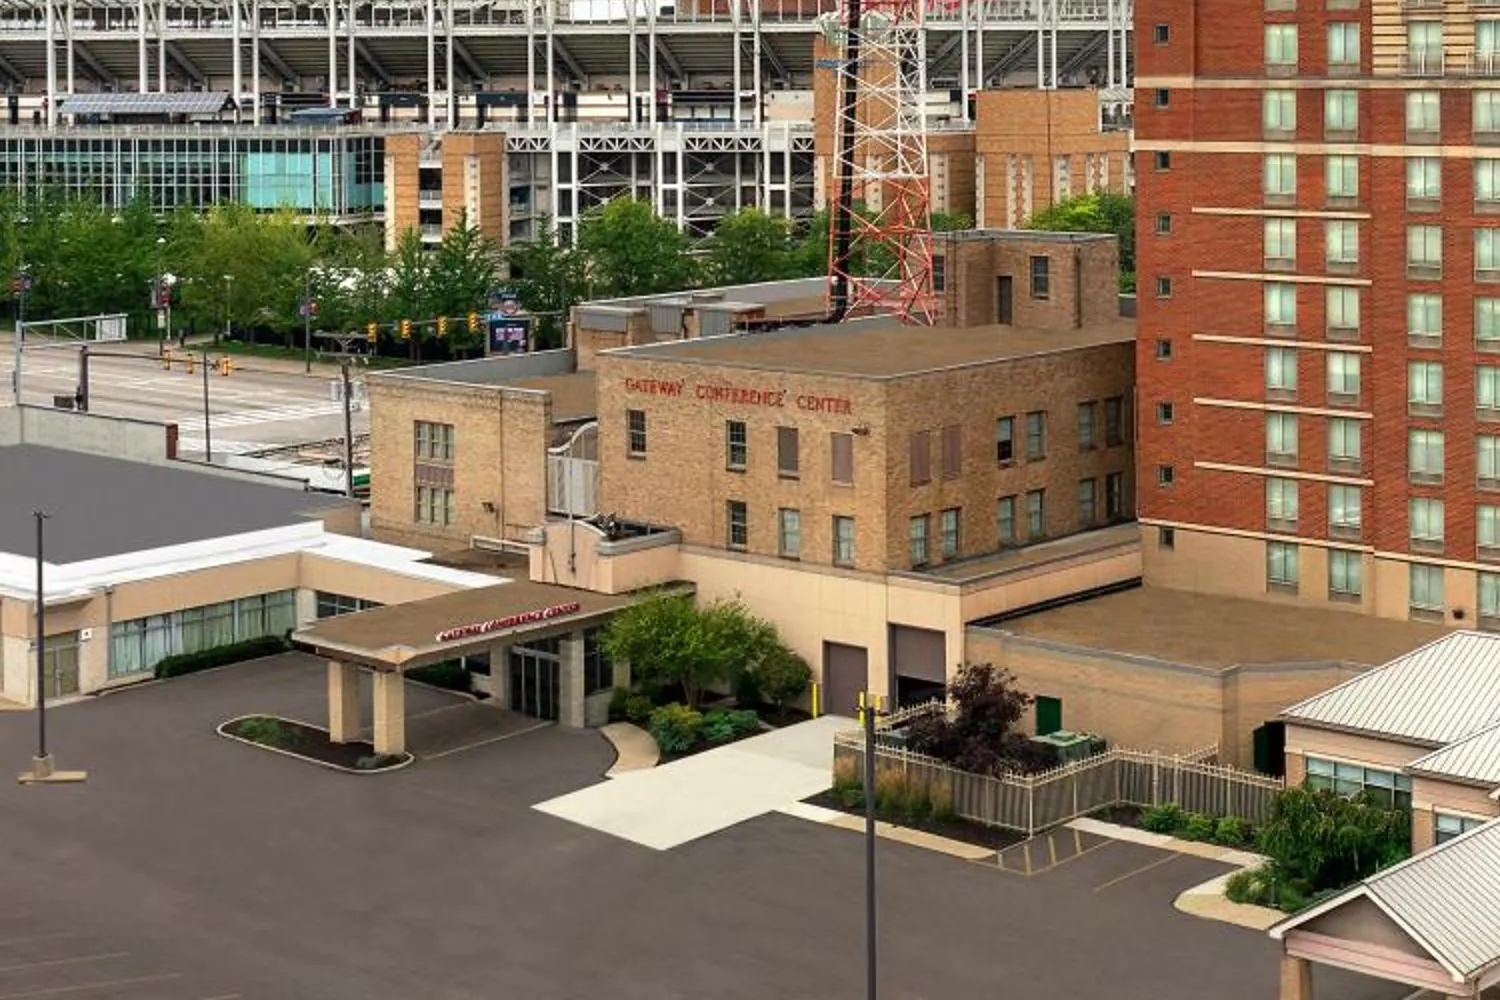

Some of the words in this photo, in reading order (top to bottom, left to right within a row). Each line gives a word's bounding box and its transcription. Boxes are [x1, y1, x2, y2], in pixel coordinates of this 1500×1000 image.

[625, 378, 683, 397] GATEWAY
[696, 384, 785, 408] CONFERENCE
[797, 395, 852, 414] CENTER
